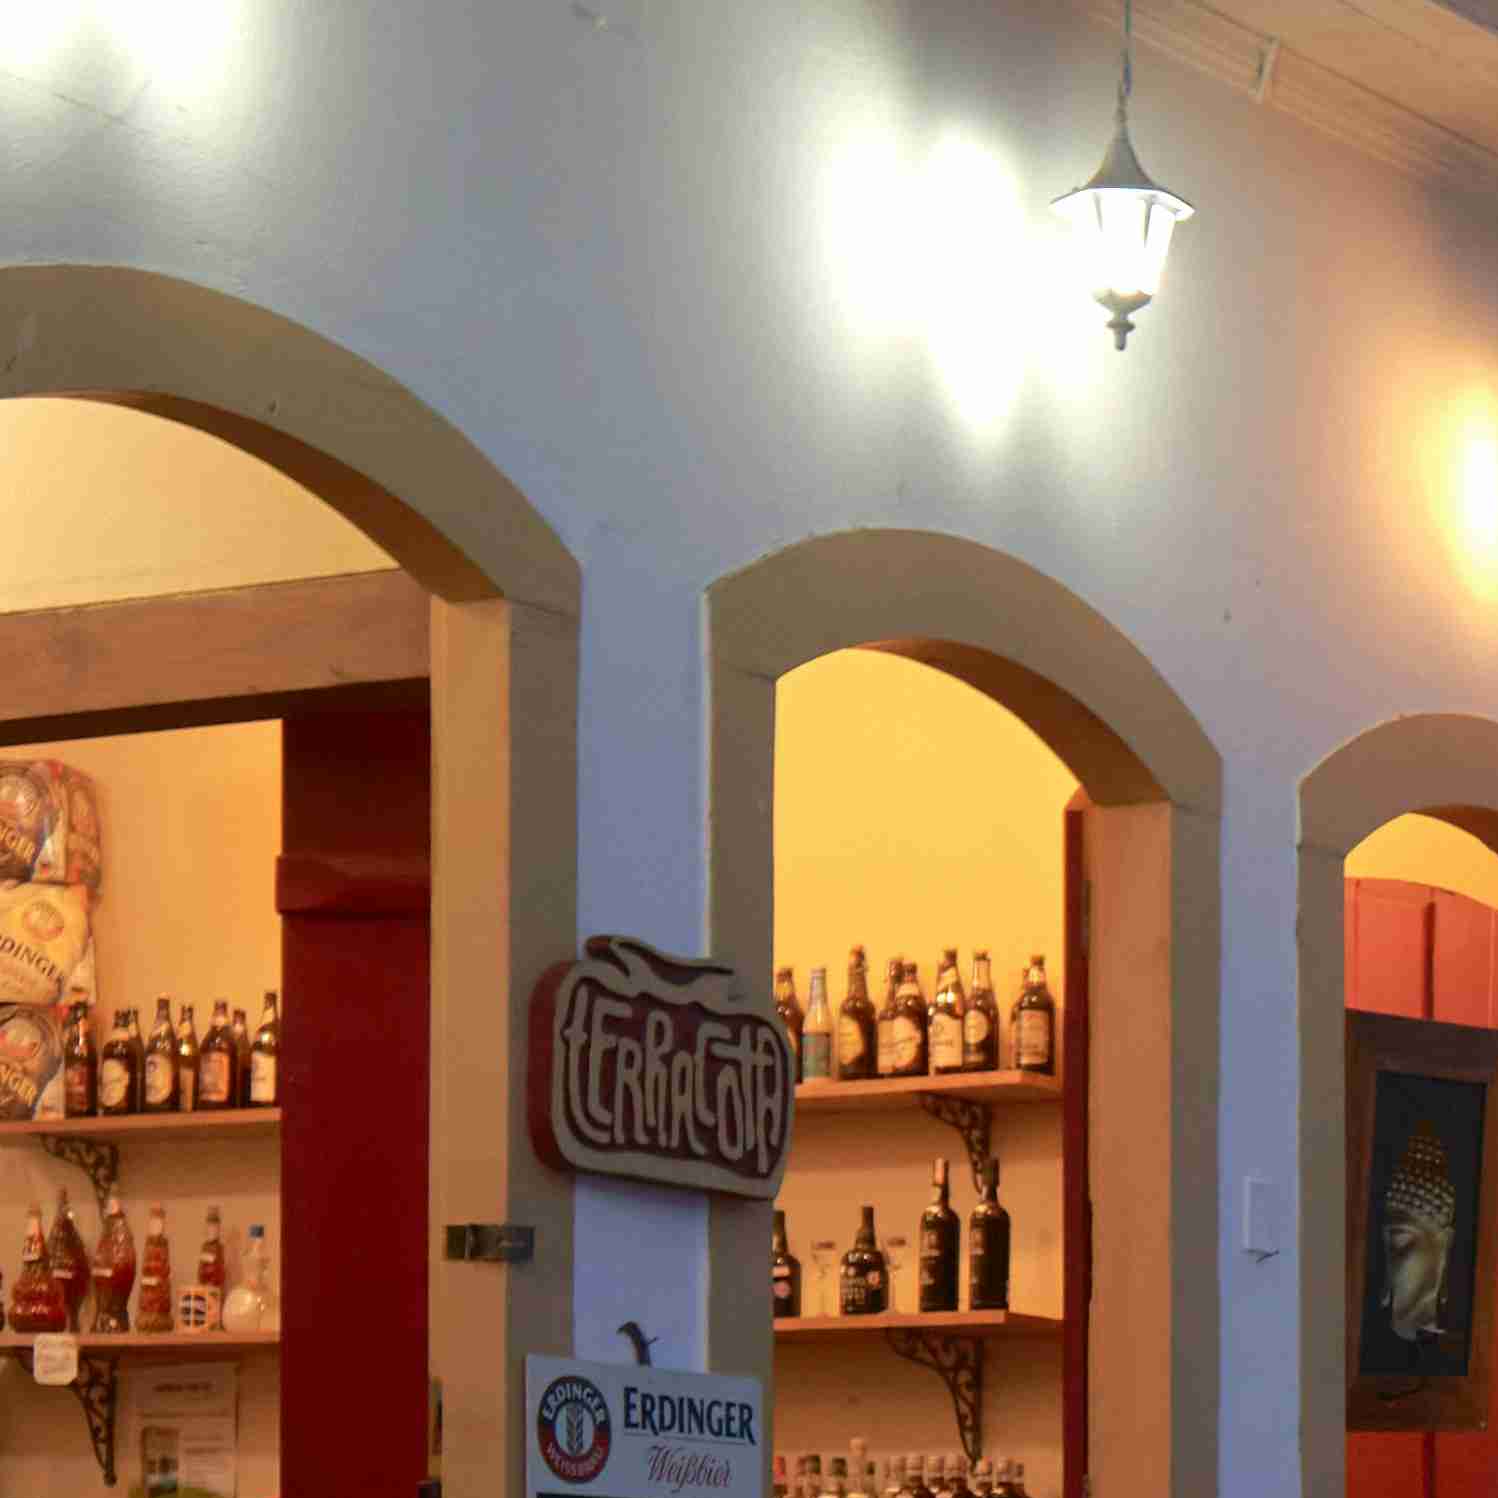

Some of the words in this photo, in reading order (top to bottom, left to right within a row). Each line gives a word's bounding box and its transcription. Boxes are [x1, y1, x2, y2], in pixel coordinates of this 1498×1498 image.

[542, 1382, 606, 1426] ERDINGER
[623, 1386, 758, 1446] ERDINGER
[647, 1445, 732, 1494] Weißbier
